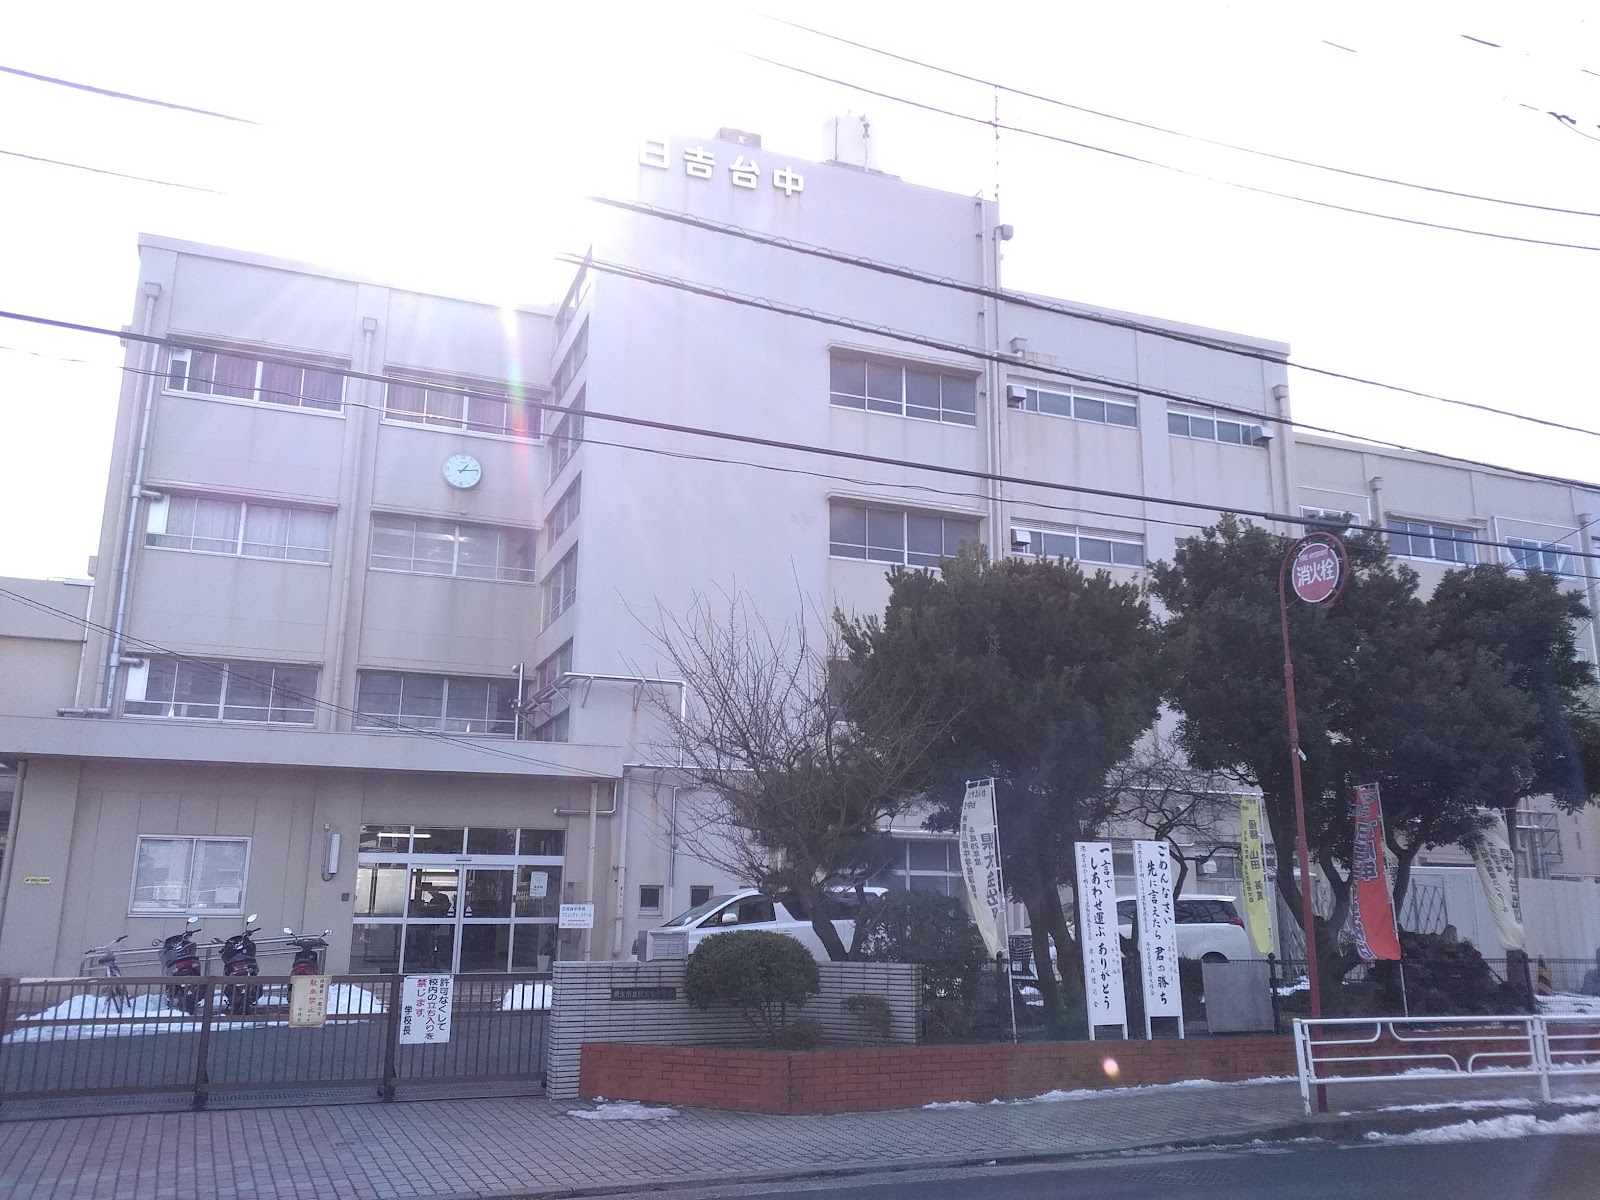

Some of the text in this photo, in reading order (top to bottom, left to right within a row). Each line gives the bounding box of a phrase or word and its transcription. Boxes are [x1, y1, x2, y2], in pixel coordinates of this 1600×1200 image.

[639, 137, 805, 196] 日吉台中
[1297, 558, 1335, 587] 消火栓
[1100, 847, 1113, 889] 一言で
[1157, 845, 1173, 925] ごめんなさい
[1090, 857, 1110, 1010] しあわせ運ぶ ありがとう
[1147, 860, 1170, 1006] 先に言えたら 君の勝ち
[402, 1005, 413, 1036] 学校長
[424, 978, 438, 1040] 校内の立ち入りを
[437, 978, 451, 1031] 許可なくして
